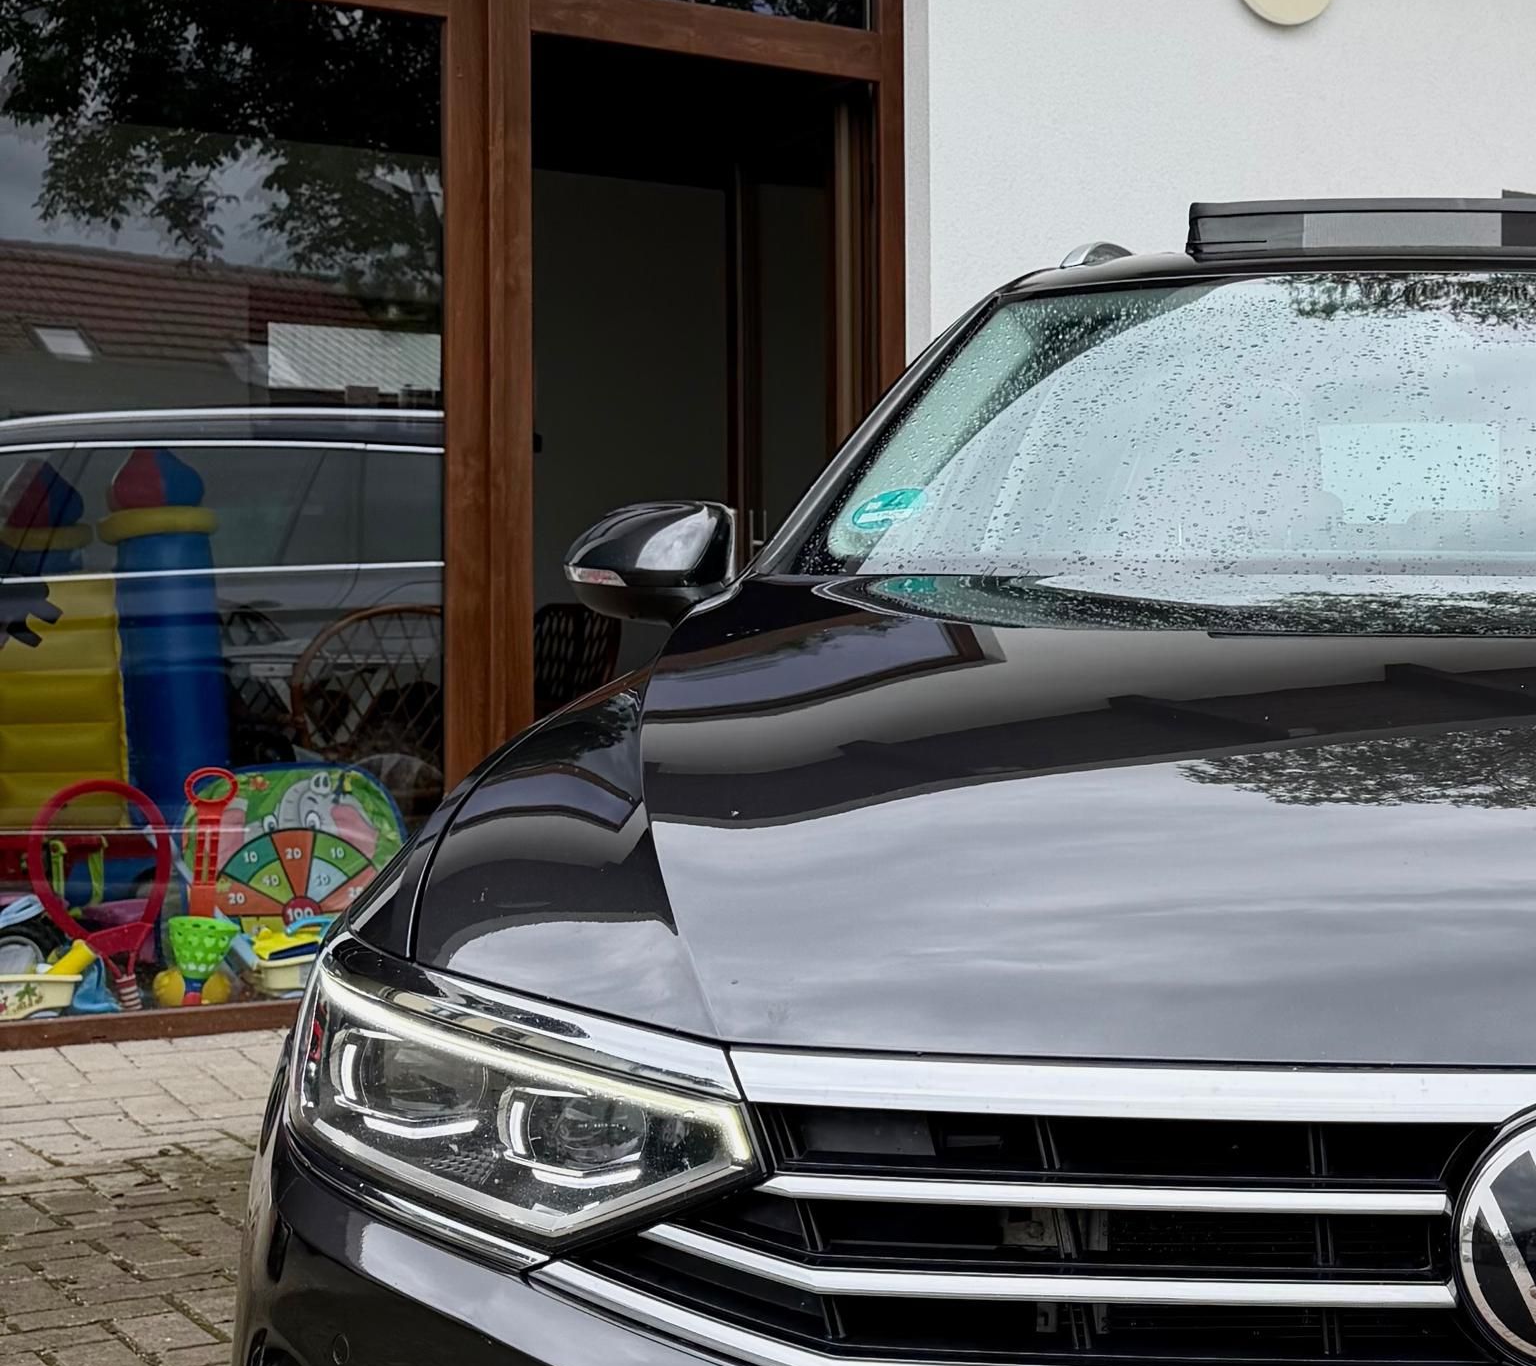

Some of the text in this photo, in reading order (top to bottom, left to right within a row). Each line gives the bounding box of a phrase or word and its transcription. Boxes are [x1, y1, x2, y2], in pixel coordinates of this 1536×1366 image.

[243, 851, 258, 863] 10
[285, 847, 302, 860] 20
[330, 847, 345, 859] 10
[228, 892, 246, 905] 20
[287, 907, 315, 922] 100
